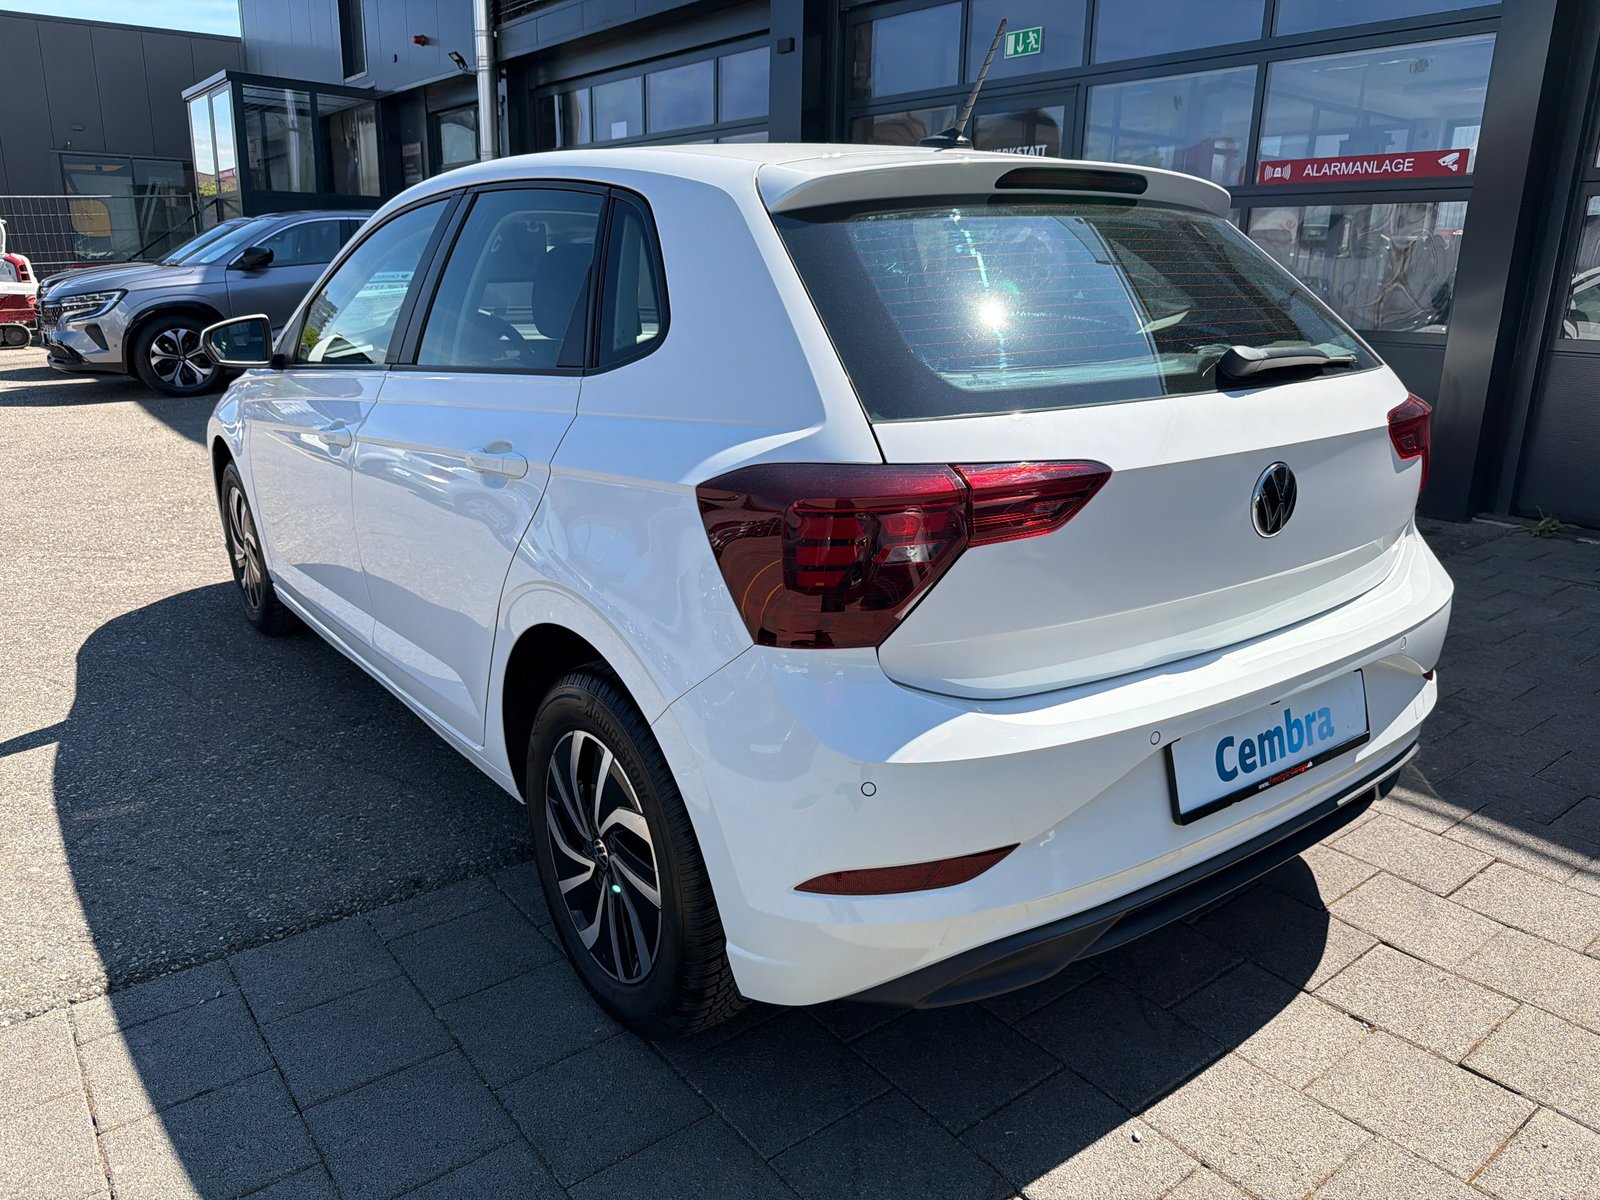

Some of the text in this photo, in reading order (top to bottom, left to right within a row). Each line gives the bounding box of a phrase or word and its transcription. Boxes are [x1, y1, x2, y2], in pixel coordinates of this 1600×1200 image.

[986, 144, 1048, 157] RKSTATT
[1302, 158, 1415, 177] ALARMANLAGE
[1215, 706, 1335, 783] Cembra
